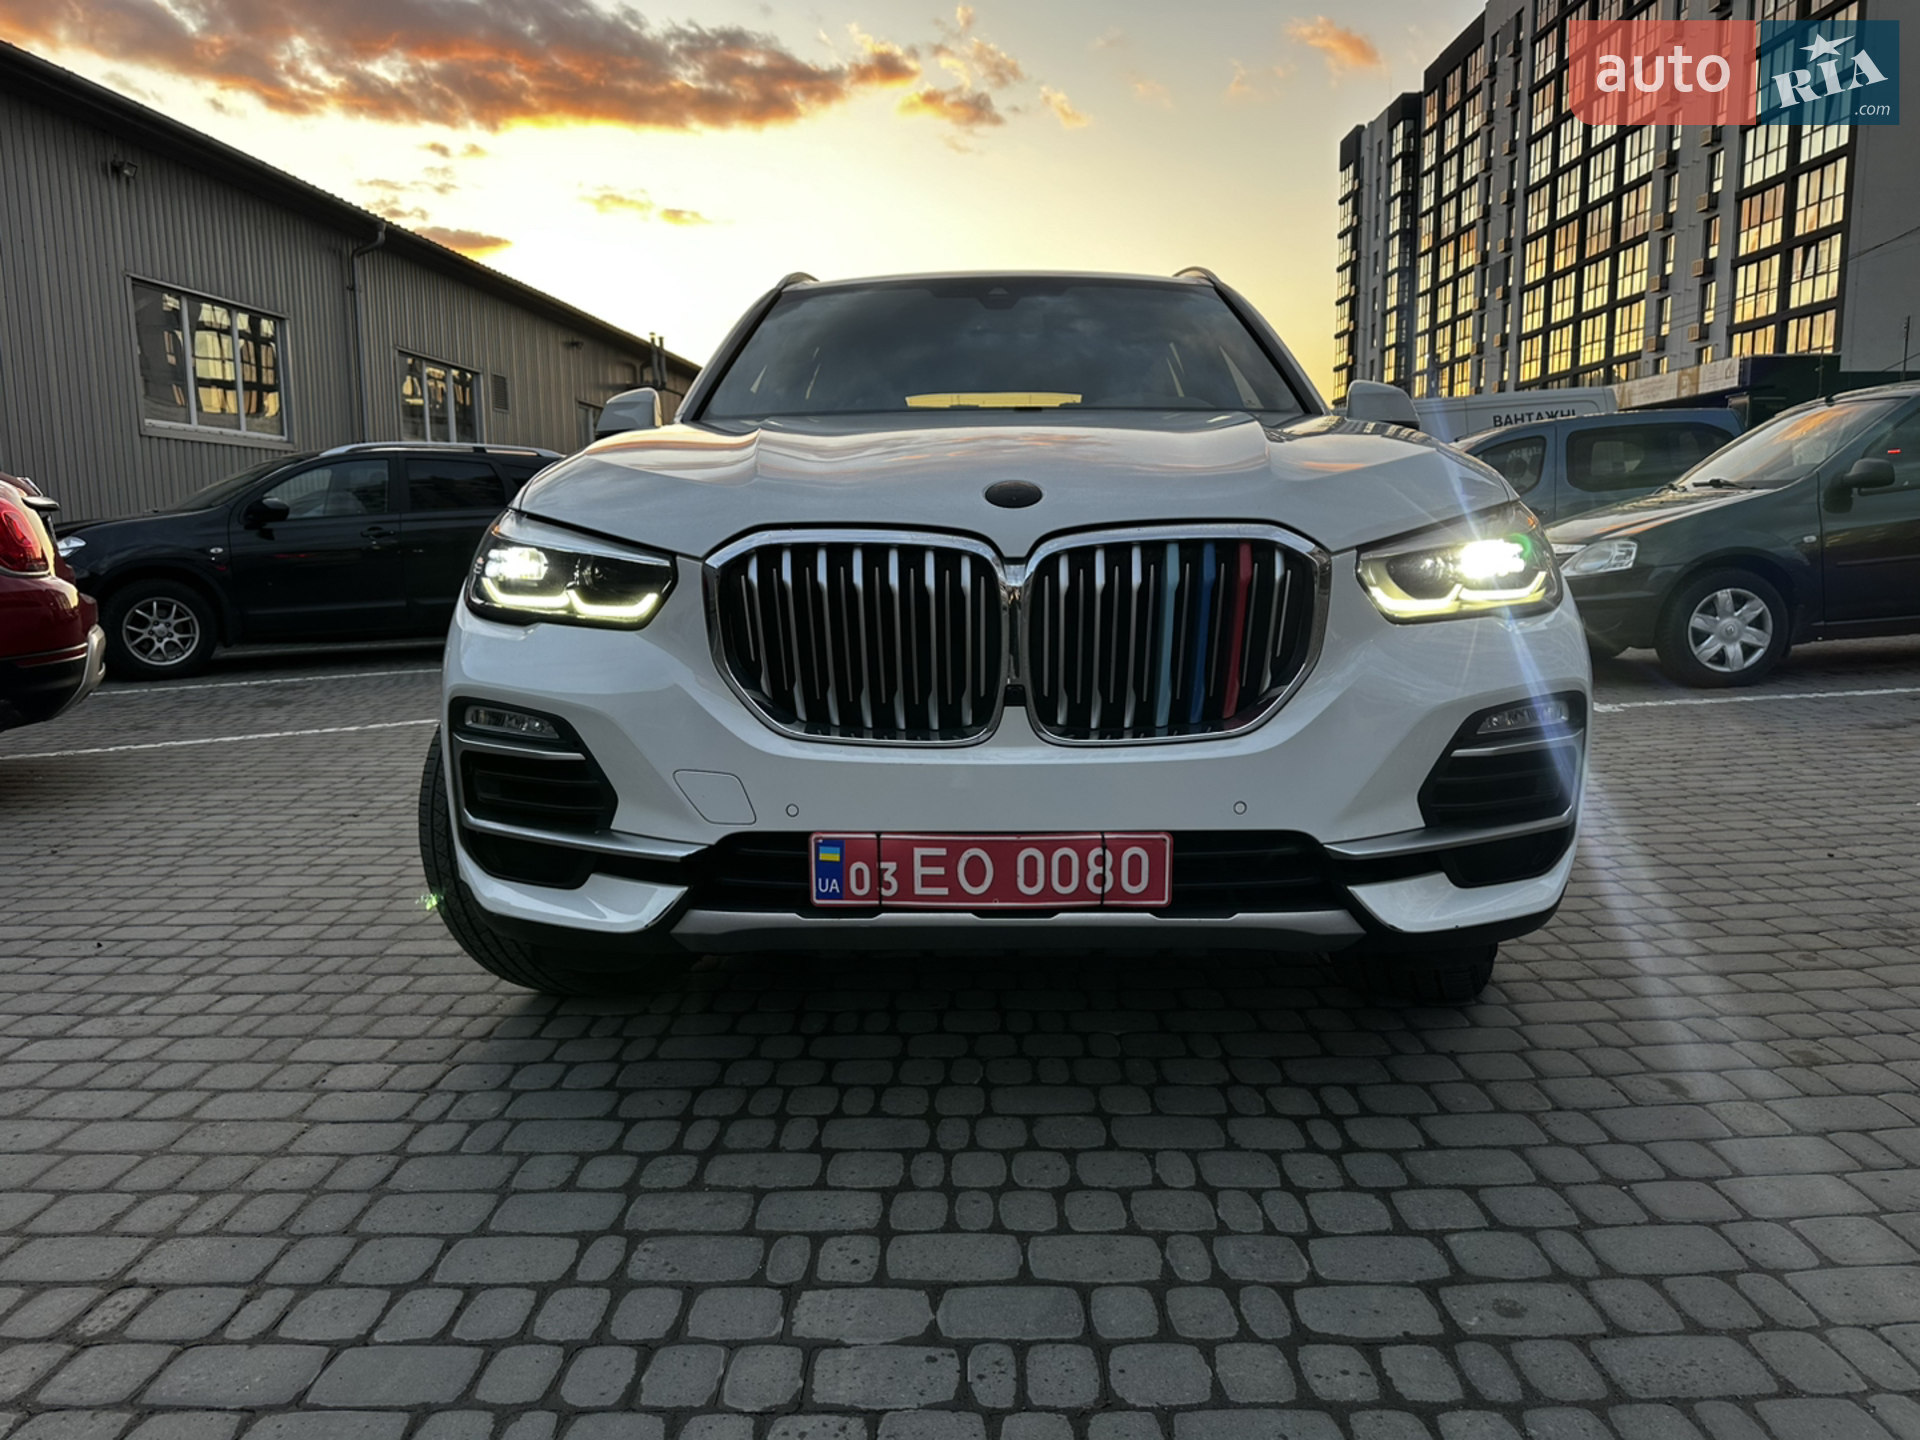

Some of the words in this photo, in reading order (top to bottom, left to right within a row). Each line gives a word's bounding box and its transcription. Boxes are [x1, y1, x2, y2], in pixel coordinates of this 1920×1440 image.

[1493, 408, 1576, 428] ВАНТАЖНІ
[849, 861, 898, 897] 03
[913, 847, 994, 896] EO
[1016, 846, 1149, 896] 0080
[818, 877, 840, 893] UA
